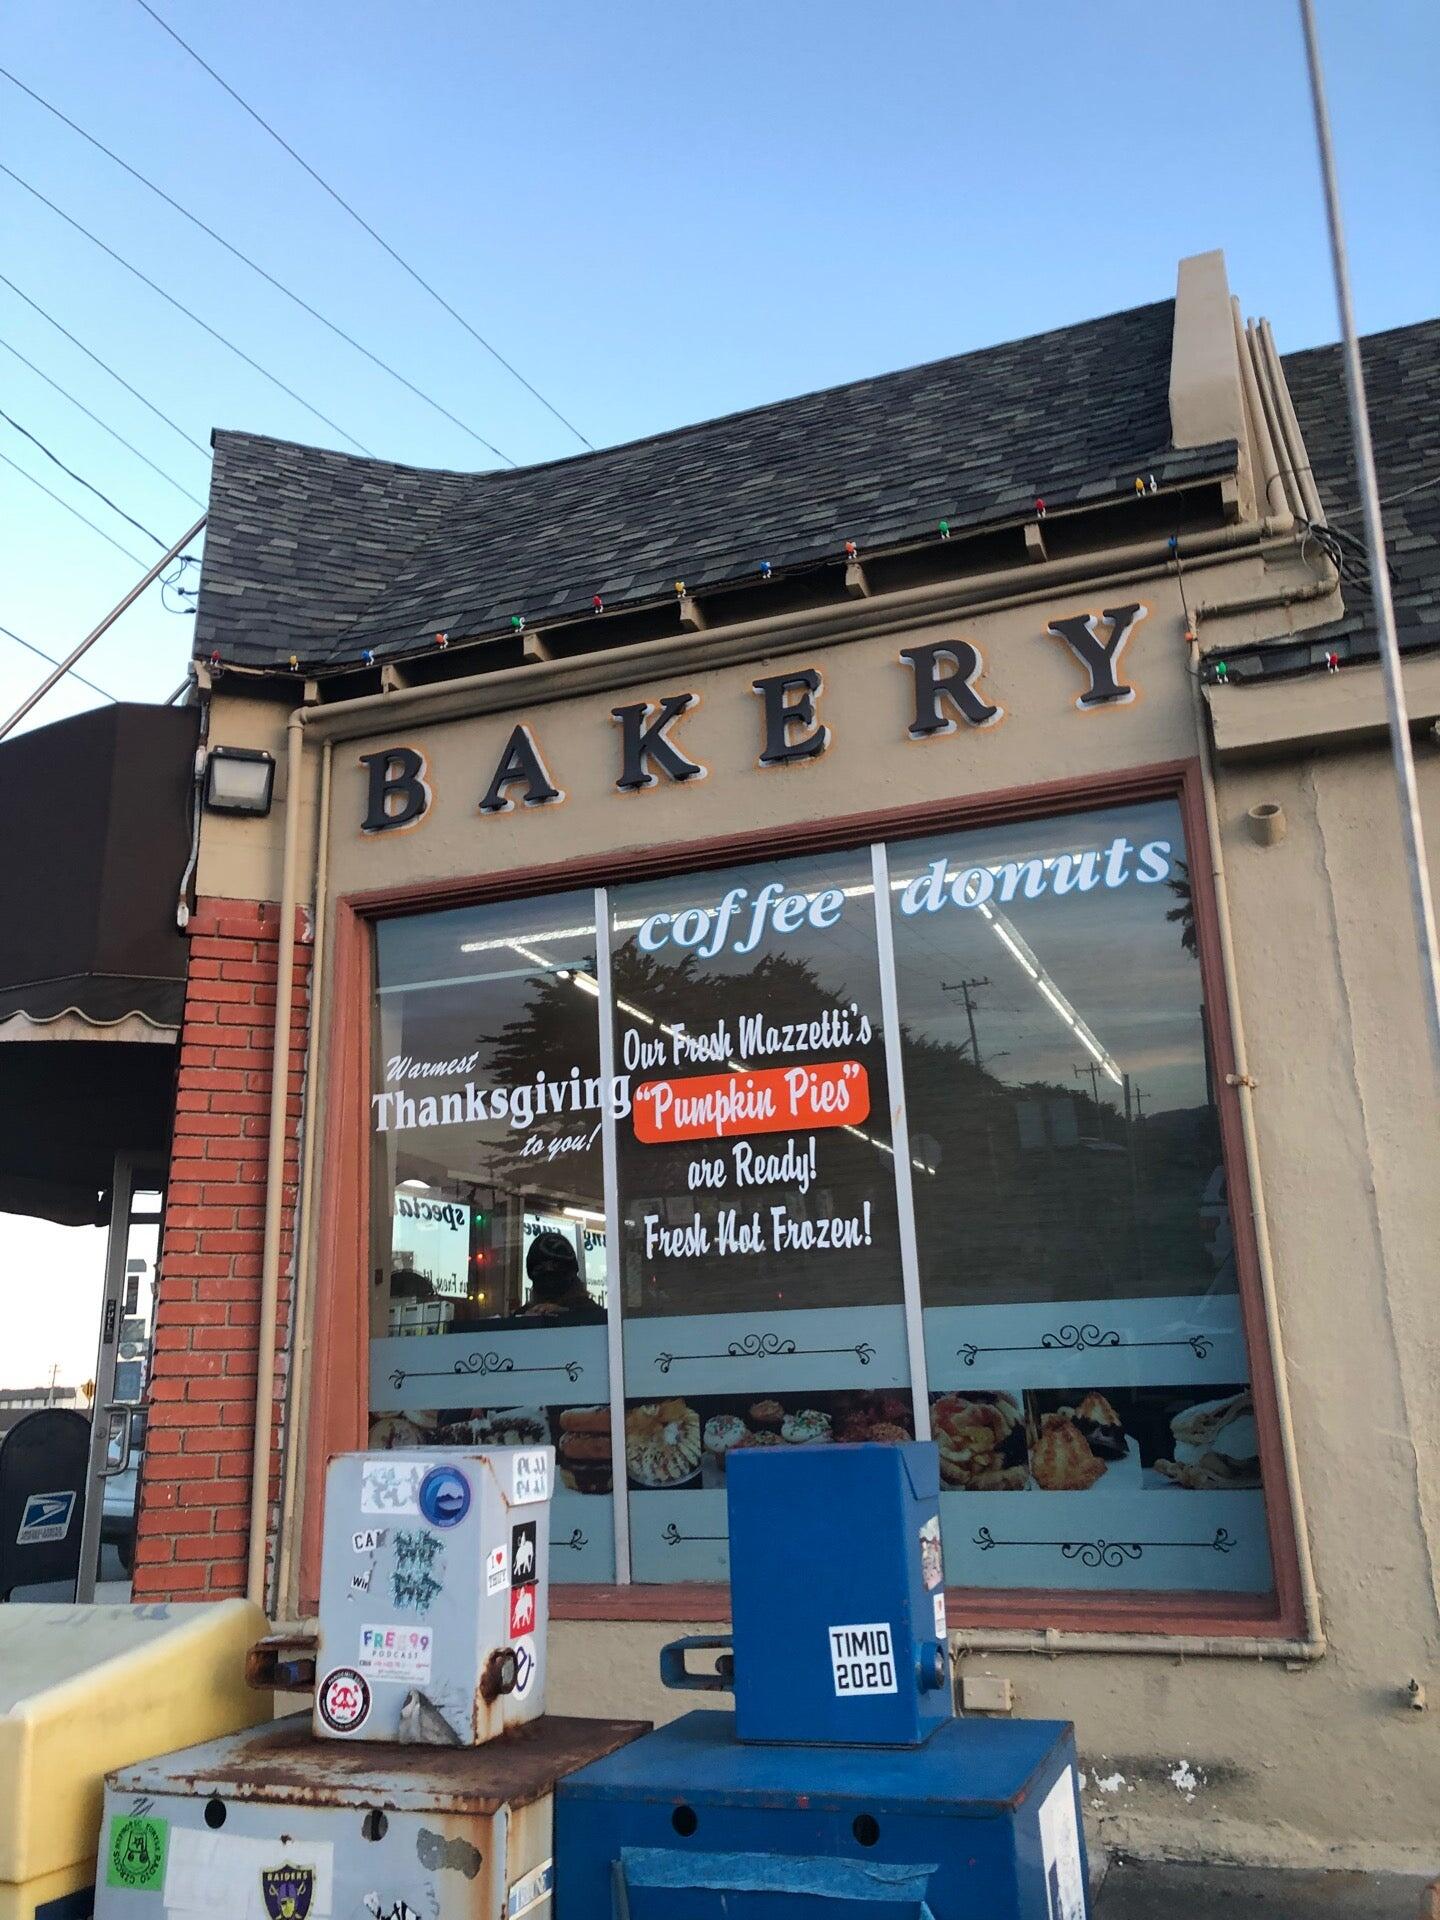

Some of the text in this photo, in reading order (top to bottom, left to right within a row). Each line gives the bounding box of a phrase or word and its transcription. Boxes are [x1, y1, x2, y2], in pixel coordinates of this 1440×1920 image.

[359, 603, 1150, 836] BAKERY
[637, 836, 1174, 959] coffee donuts
[623, 1003, 872, 1072] Our Fresh Mazzetti's
[387, 1050, 479, 1082] Warmest
[372, 1066, 631, 1132] Thanksgiving
[520, 1122, 600, 1163] to you!
[688, 1137, 817, 1194] are Ready!
[644, 1215, 710, 1258] Fresh
[717, 1209, 764, 1255] Not
[771, 1202, 872, 1250] Frozen!
[372, 1650, 418, 1658] PODCAST
[832, 1630, 889, 1658] TIMID
[836, 1662, 893, 1690] 2020
[267, 1872, 307, 1881] RAIDERS
